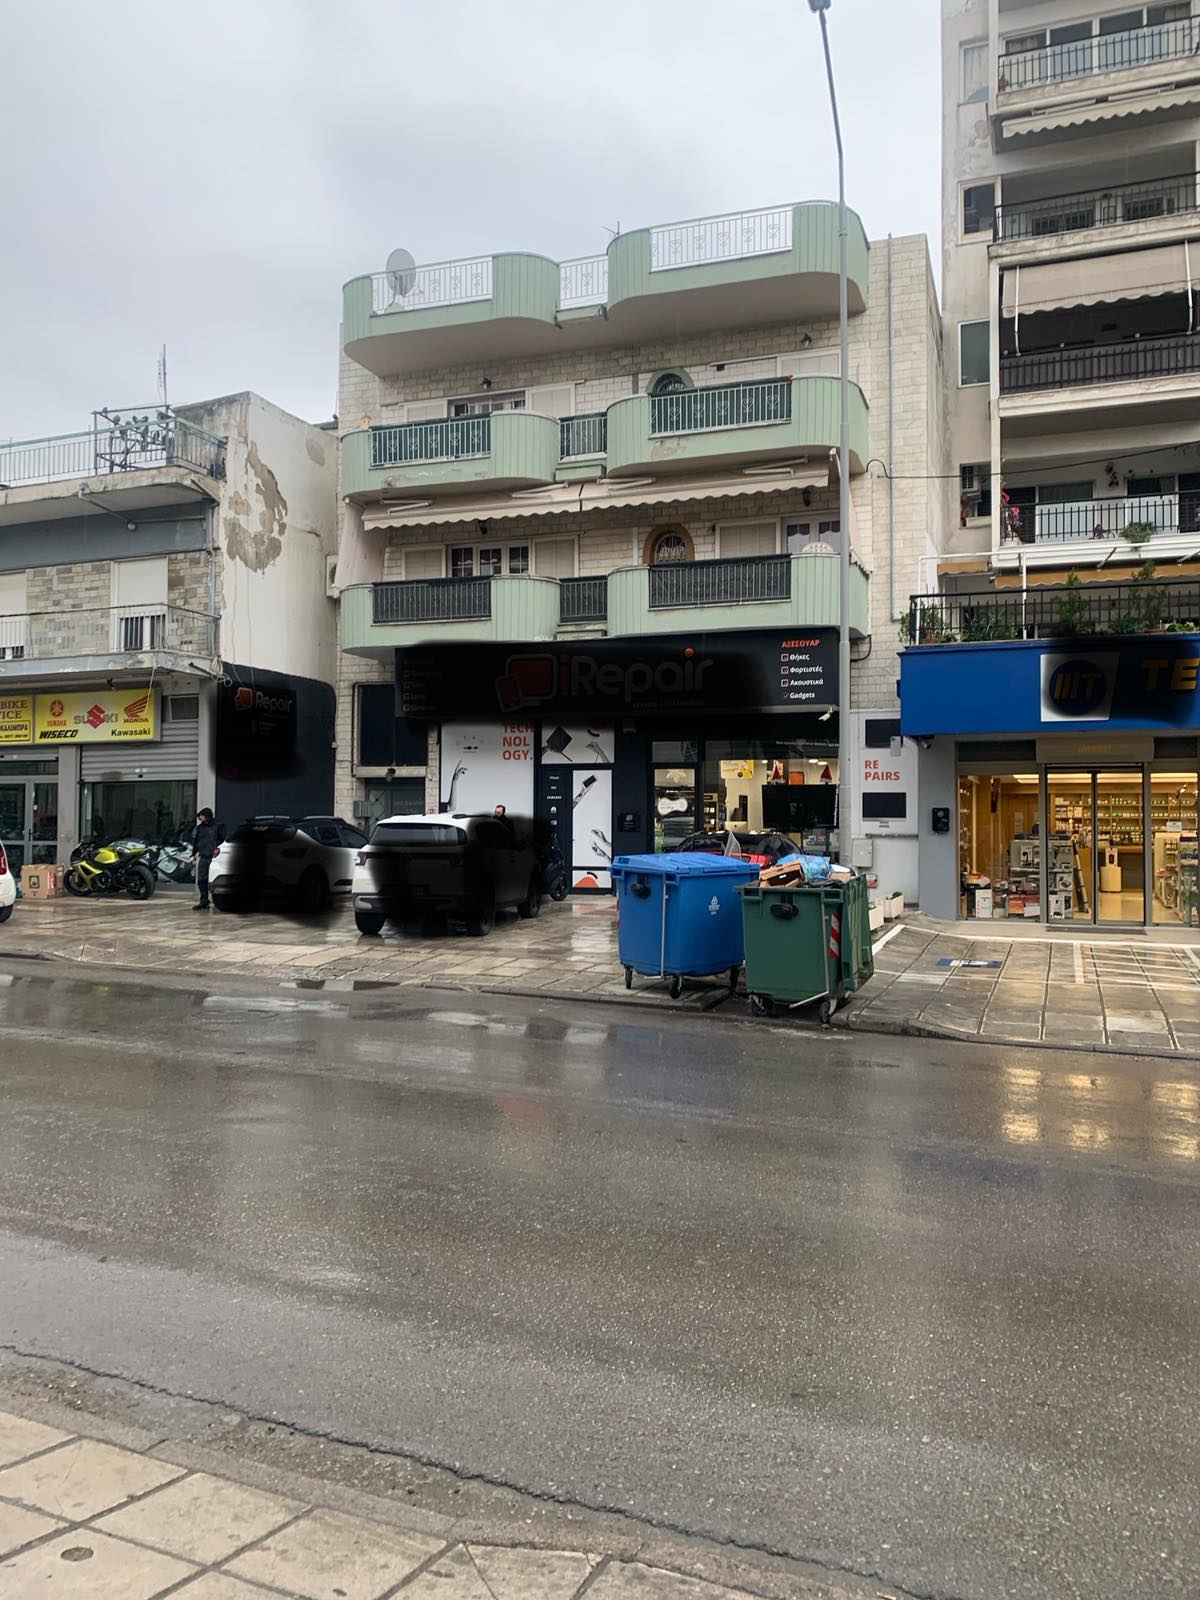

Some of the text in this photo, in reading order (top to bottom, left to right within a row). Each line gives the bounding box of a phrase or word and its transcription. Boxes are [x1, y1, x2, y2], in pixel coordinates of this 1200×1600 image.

[789, 653, 810, 662] Θήκες
[789, 665, 823, 674] Φορτιστές
[789, 678, 824, 686] Ακουστικά
[789, 692, 816, 700] Gadgets
[39, 729, 79, 739] WISECO
[111, 728, 151, 736] Kawasaki
[503, 737, 529, 746] NOL
[864, 760, 879, 769] RE
[864, 772, 900, 781] PAIRS
